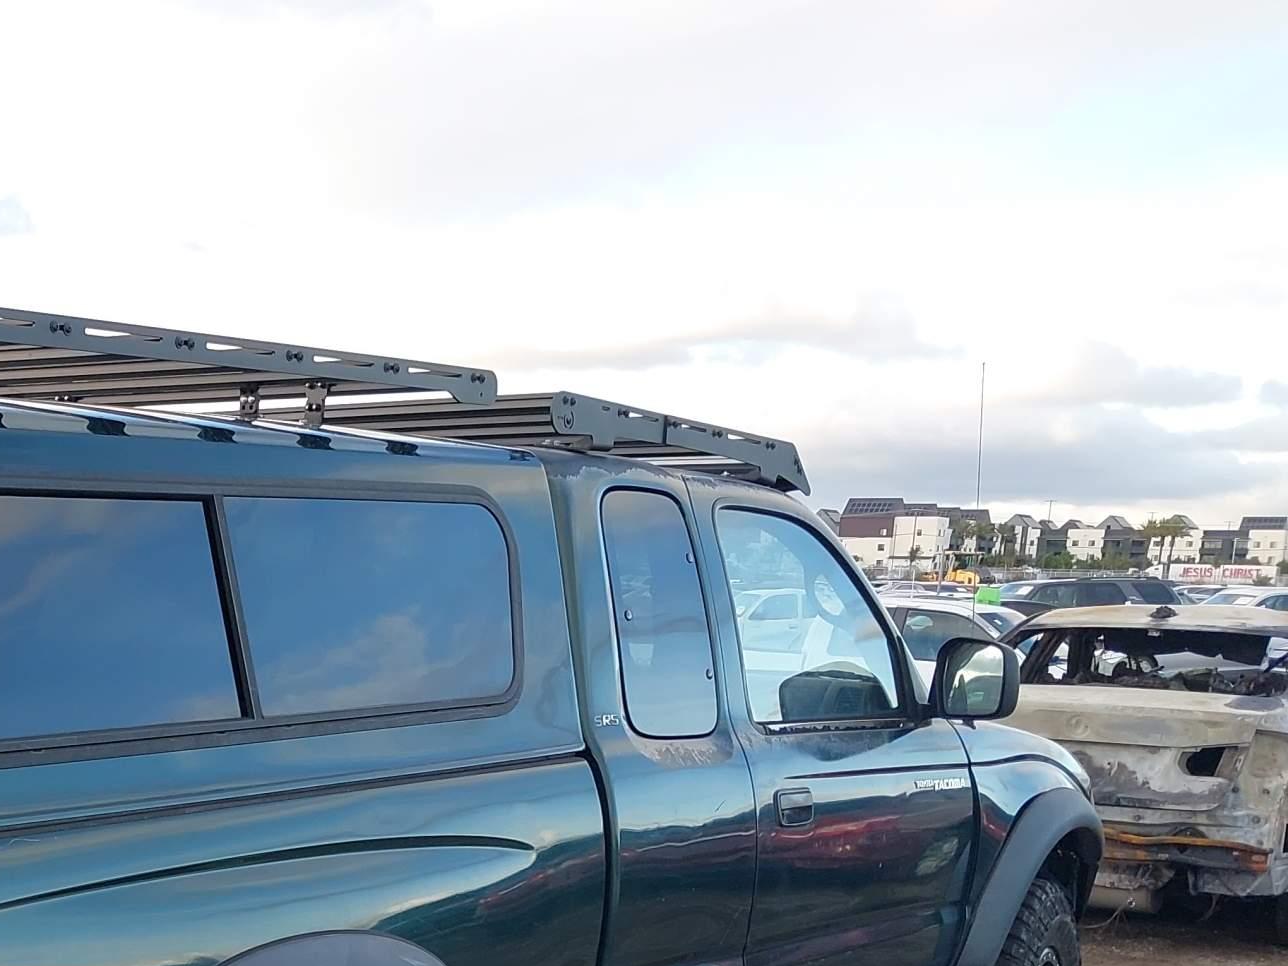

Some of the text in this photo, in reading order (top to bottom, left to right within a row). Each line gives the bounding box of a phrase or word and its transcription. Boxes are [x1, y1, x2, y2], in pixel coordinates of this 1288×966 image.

[1179, 567, 1261, 579] JESUS CHRIST
[594, 714, 620, 727] SR5
